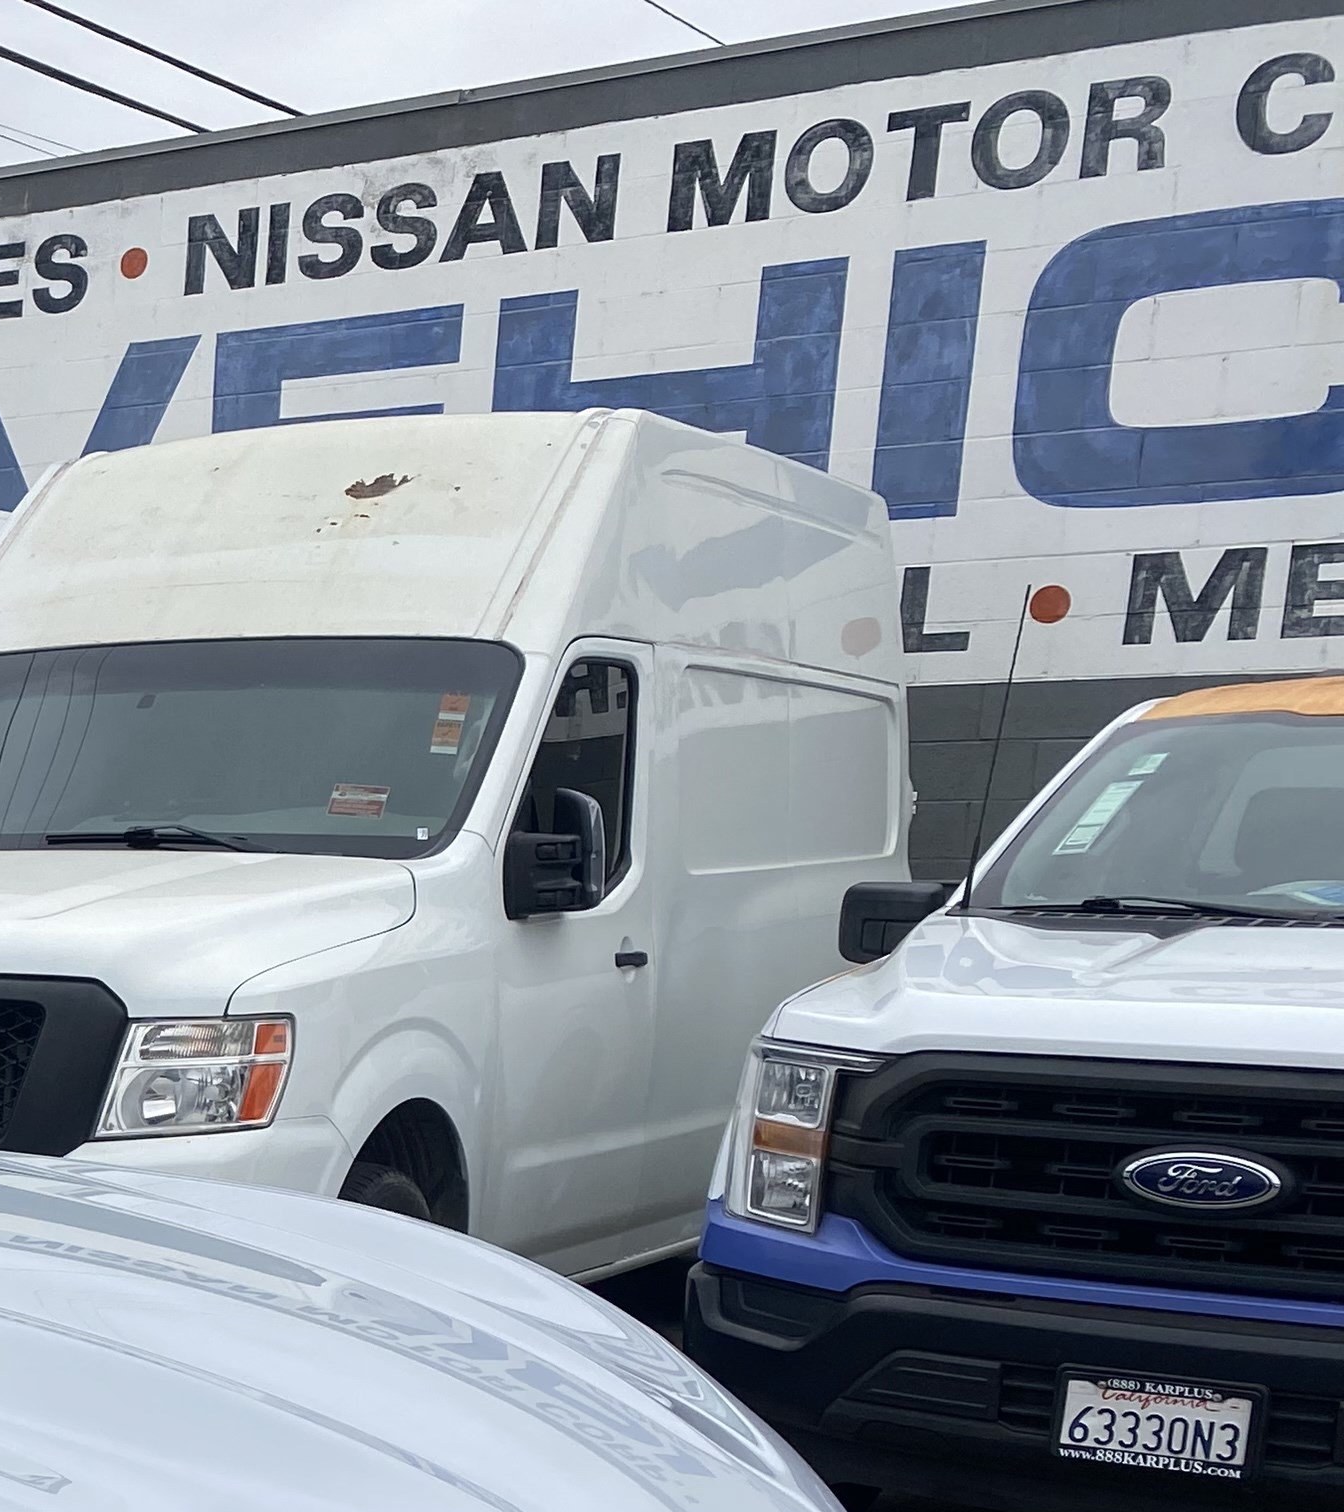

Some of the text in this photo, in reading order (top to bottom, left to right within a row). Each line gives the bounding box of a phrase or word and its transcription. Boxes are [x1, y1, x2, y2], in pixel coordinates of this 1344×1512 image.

[183, 151, 621, 298] NISSAN
[668, 74, 1173, 233] MOTOR
[1158, 1163, 1243, 1197] Ford
[1108, 1378, 1213, 1399] (888) KARPLUS
[1068, 1406, 1240, 1461] 63330N3
